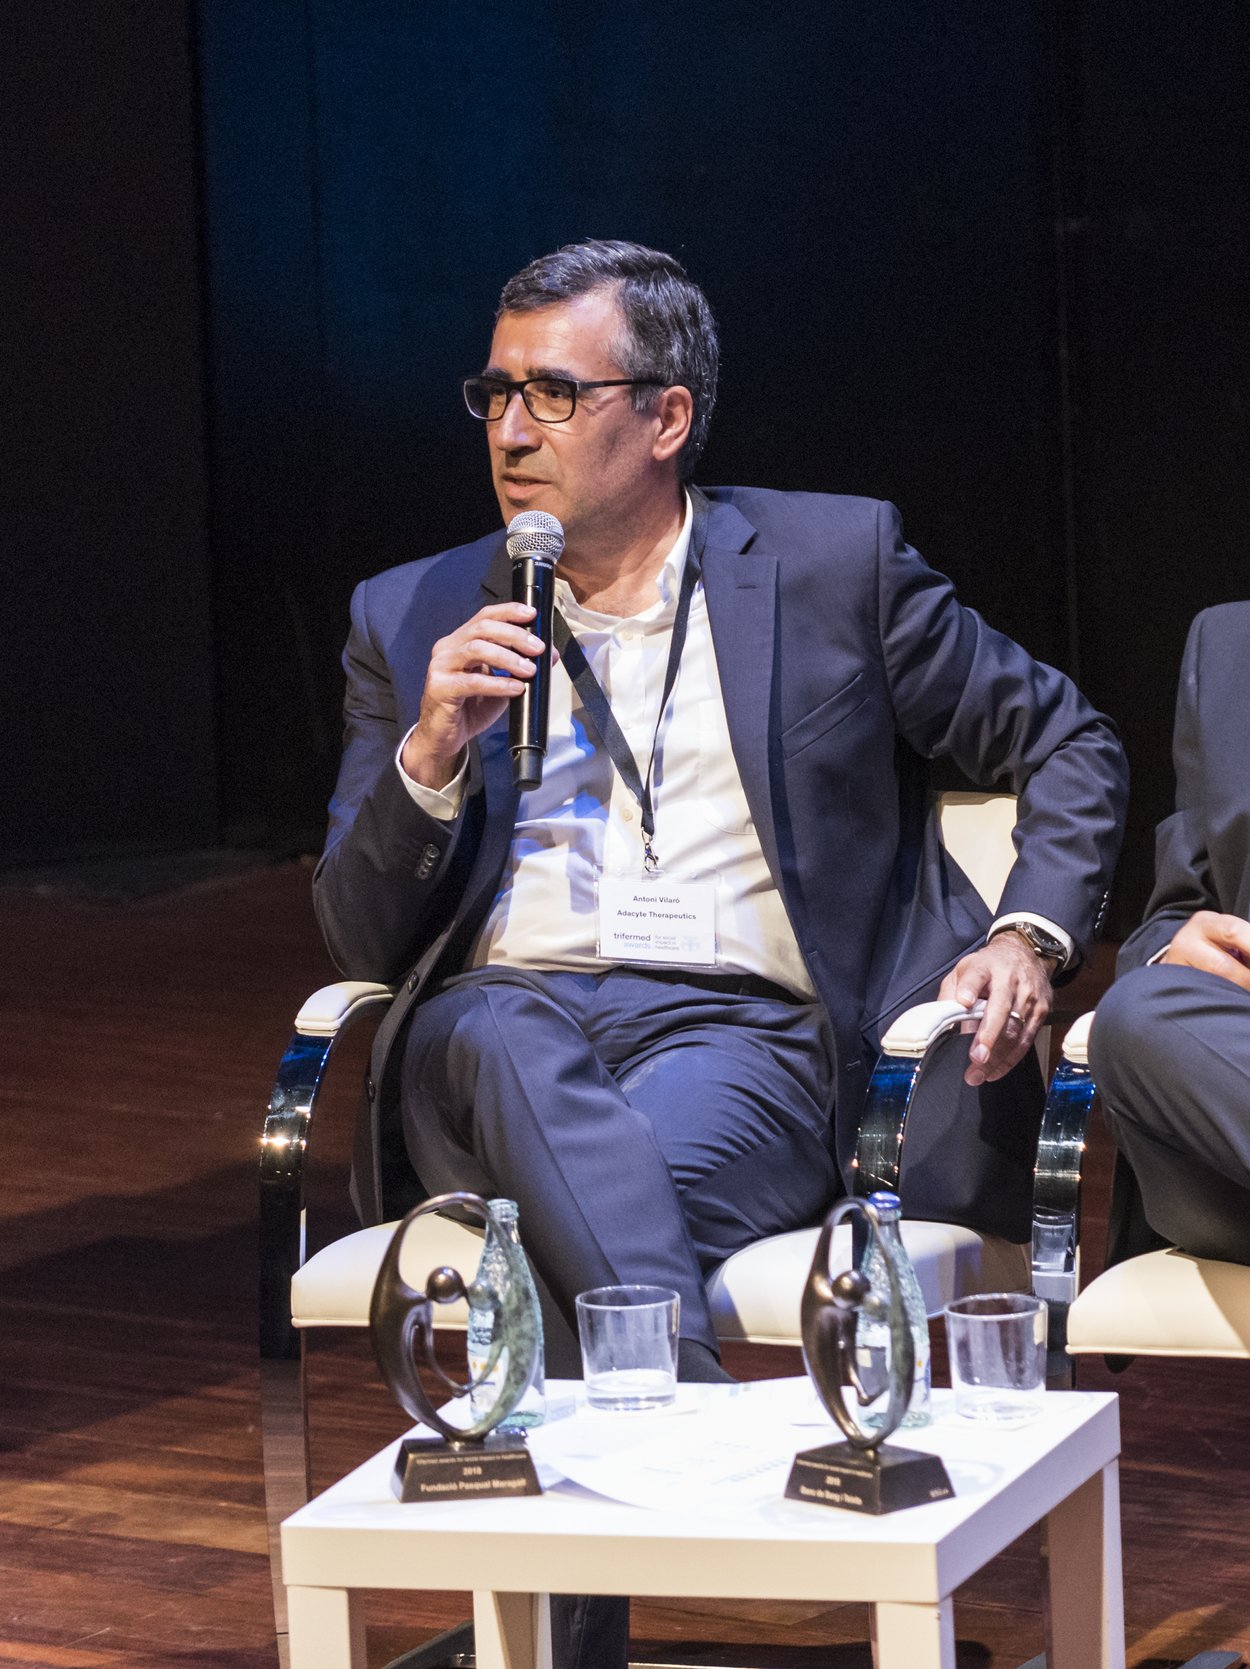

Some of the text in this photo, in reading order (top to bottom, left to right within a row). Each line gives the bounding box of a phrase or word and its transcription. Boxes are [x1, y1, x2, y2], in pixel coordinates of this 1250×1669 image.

[633, 895, 657, 903] Antoni
[617, 909, 697, 920] Adacyte Therapeutics
[613, 932, 651, 942] trifermed
